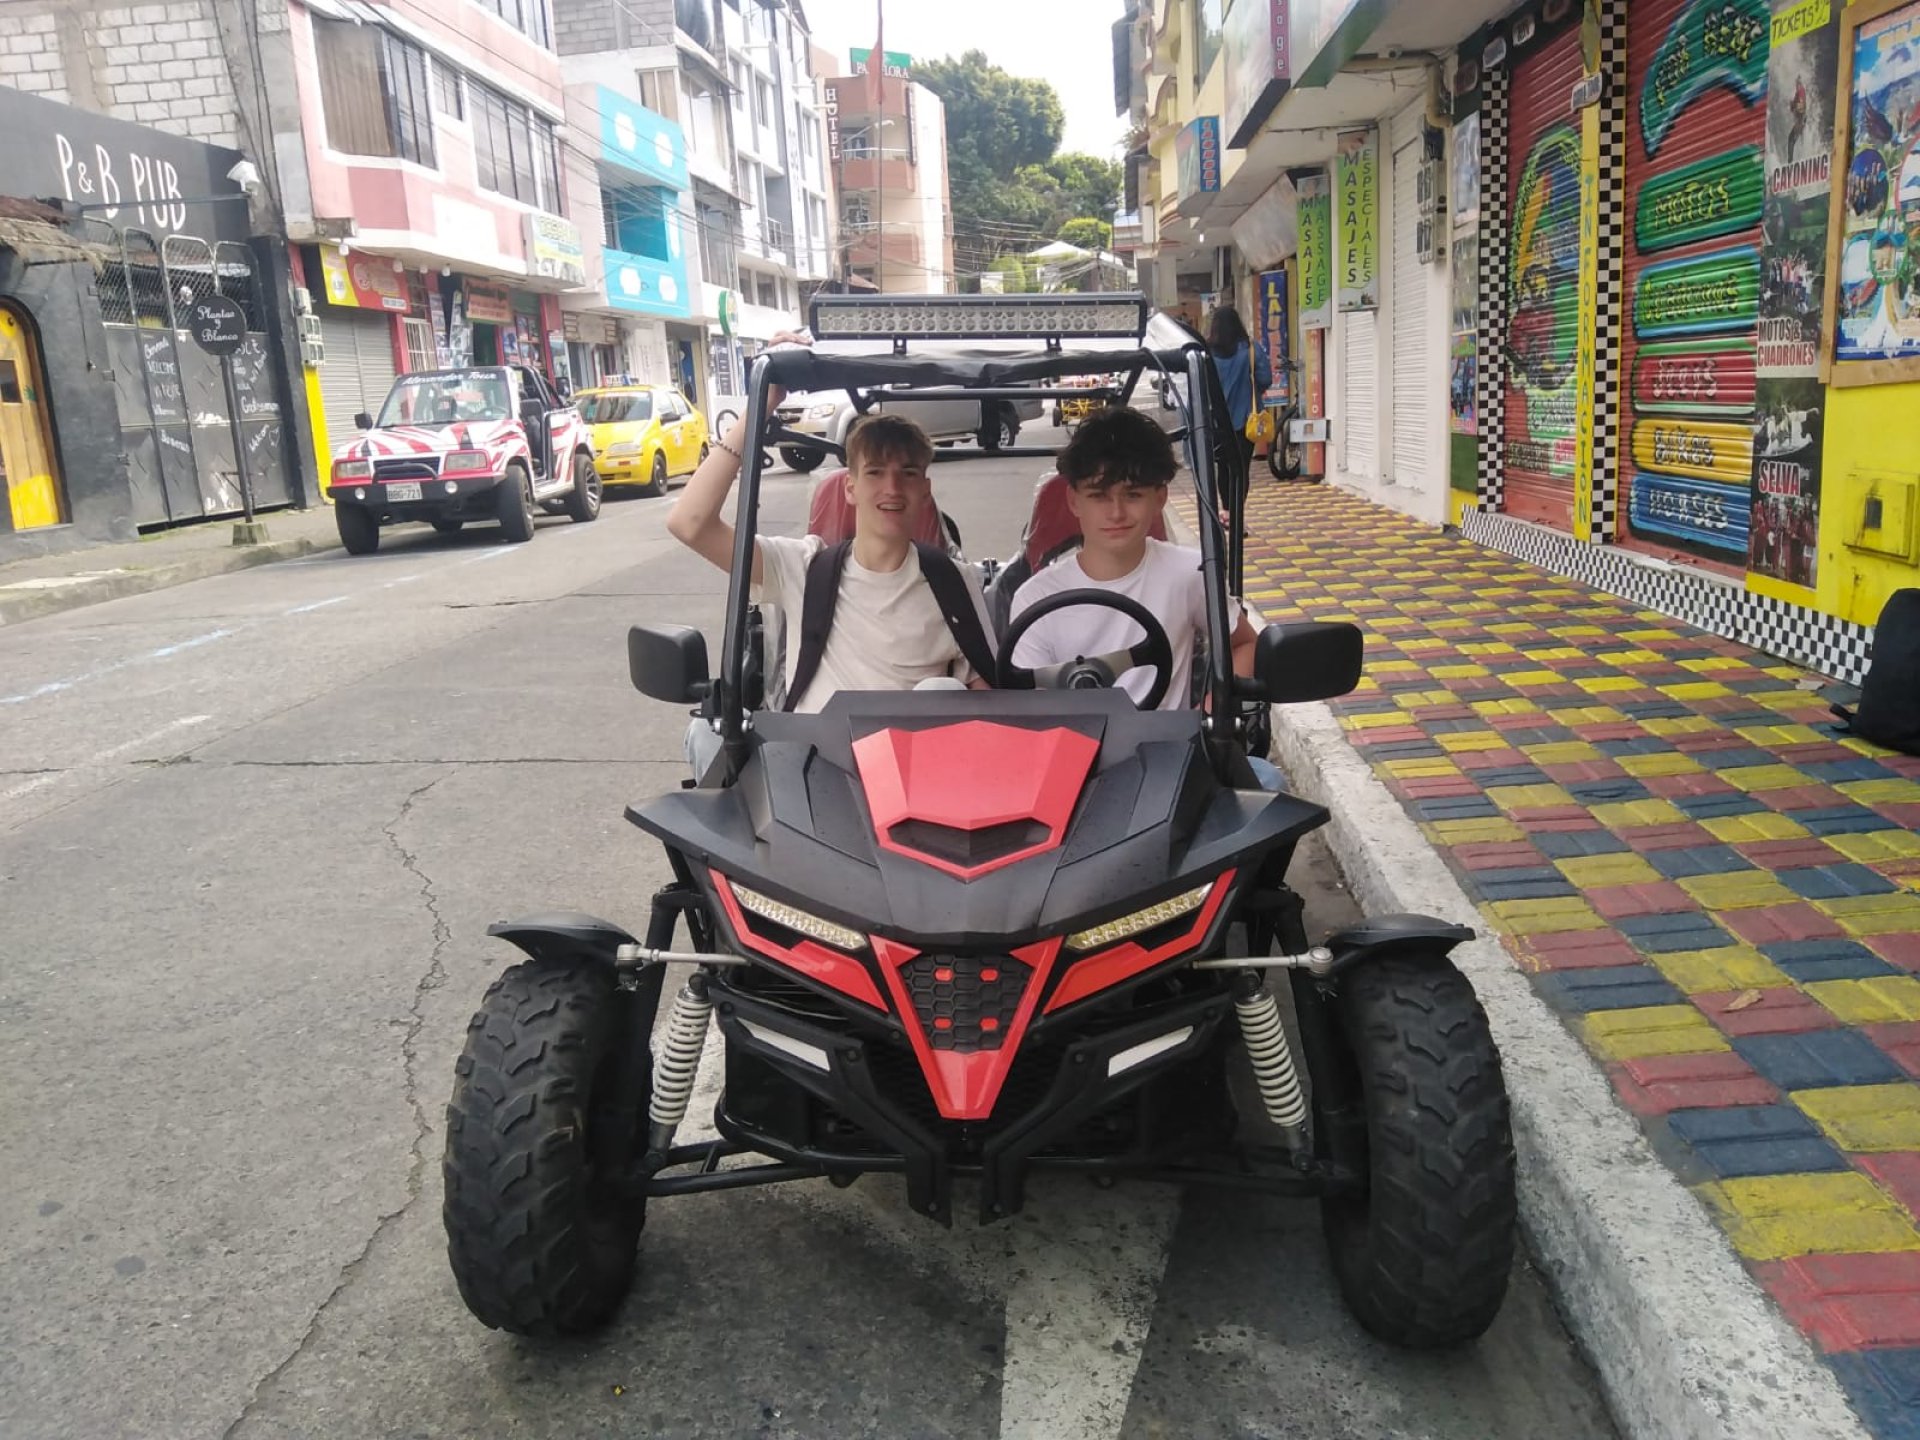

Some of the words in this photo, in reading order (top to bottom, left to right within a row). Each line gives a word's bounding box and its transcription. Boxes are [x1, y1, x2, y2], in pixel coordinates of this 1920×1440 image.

[1771, 5, 1814, 41] TICKETS
[825, 88, 840, 160] HOTEL
[56, 133, 74, 201] P
[78, 161, 95, 193] &
[95, 143, 120, 220] B
[129, 152, 187, 232] PUB
[1773, 153, 1828, 193] CAYONING
[1301, 198, 1313, 305] MASAJES
[1314, 194, 1326, 302] MASSAGE
[1343, 152, 1359, 283] MASAJES
[1362, 149, 1372, 283] ESPECIALES
[1757, 343, 1815, 367] CUADRONES
[1758, 318, 1792, 342] MOTOS
[1758, 459, 1801, 497] SELVA
